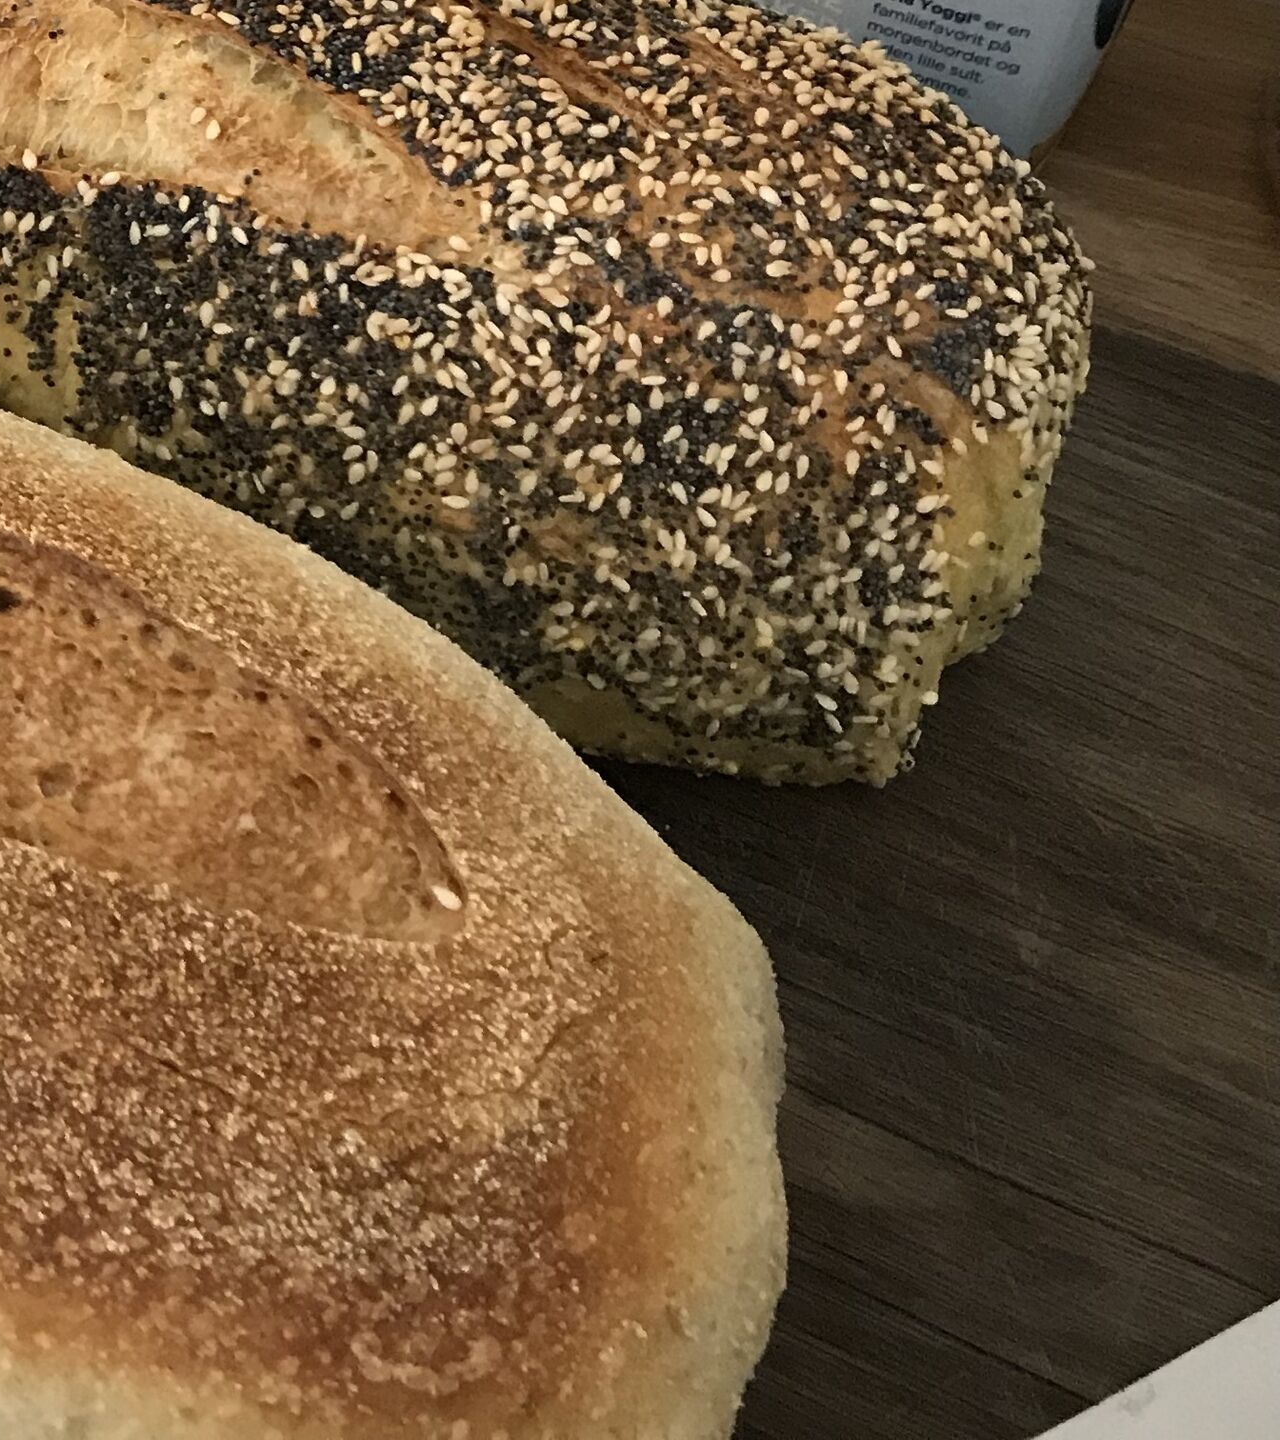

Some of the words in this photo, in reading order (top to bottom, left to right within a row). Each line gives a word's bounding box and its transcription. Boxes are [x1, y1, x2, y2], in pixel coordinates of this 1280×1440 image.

[866, 20, 991, 68] morgenbordet
[996, 59, 1022, 76] og
[872, 2, 985, 48] familiefavorit
[987, 37, 1012, 54] på
[984, 18, 1005, 32] er
[1007, 25, 1032, 40] en
[917, 49, 946, 72] lille
[949, 64, 985, 85] sult.
